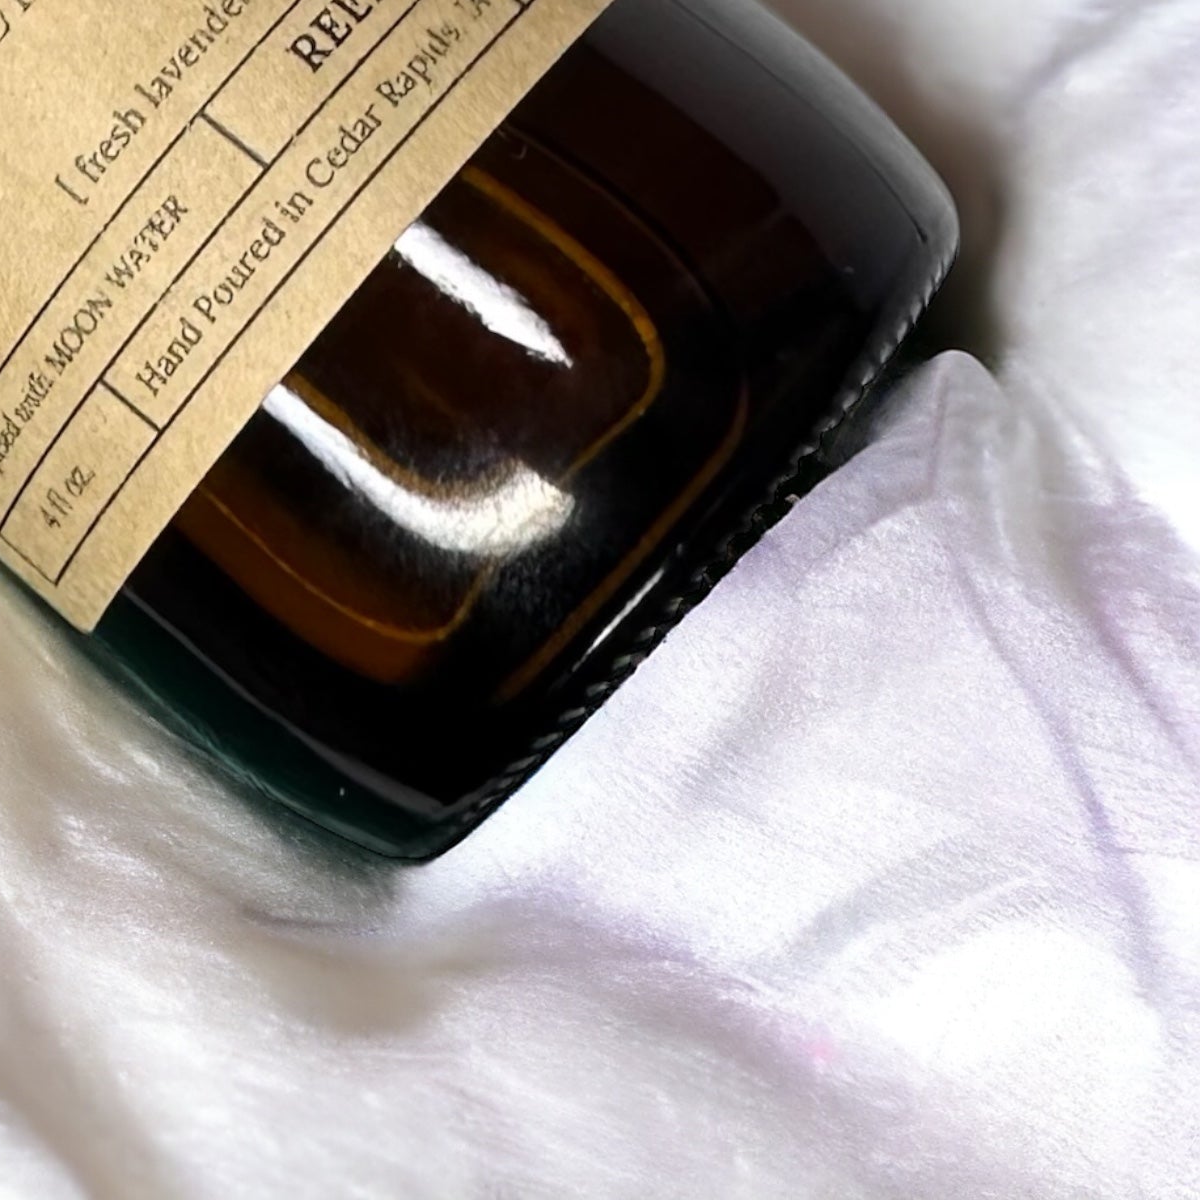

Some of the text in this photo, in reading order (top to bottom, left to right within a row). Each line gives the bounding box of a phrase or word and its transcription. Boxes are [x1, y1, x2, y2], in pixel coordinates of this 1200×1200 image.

[75, 110, 147, 184] fresh
[45, 293, 113, 375] MOON
[105, 194, 189, 289] WATER
[135, 316, 203, 397] Hand
[193, 216, 287, 324] Poured
[274, 191, 315, 224] in
[305, 103, 382, 188] Cedar
